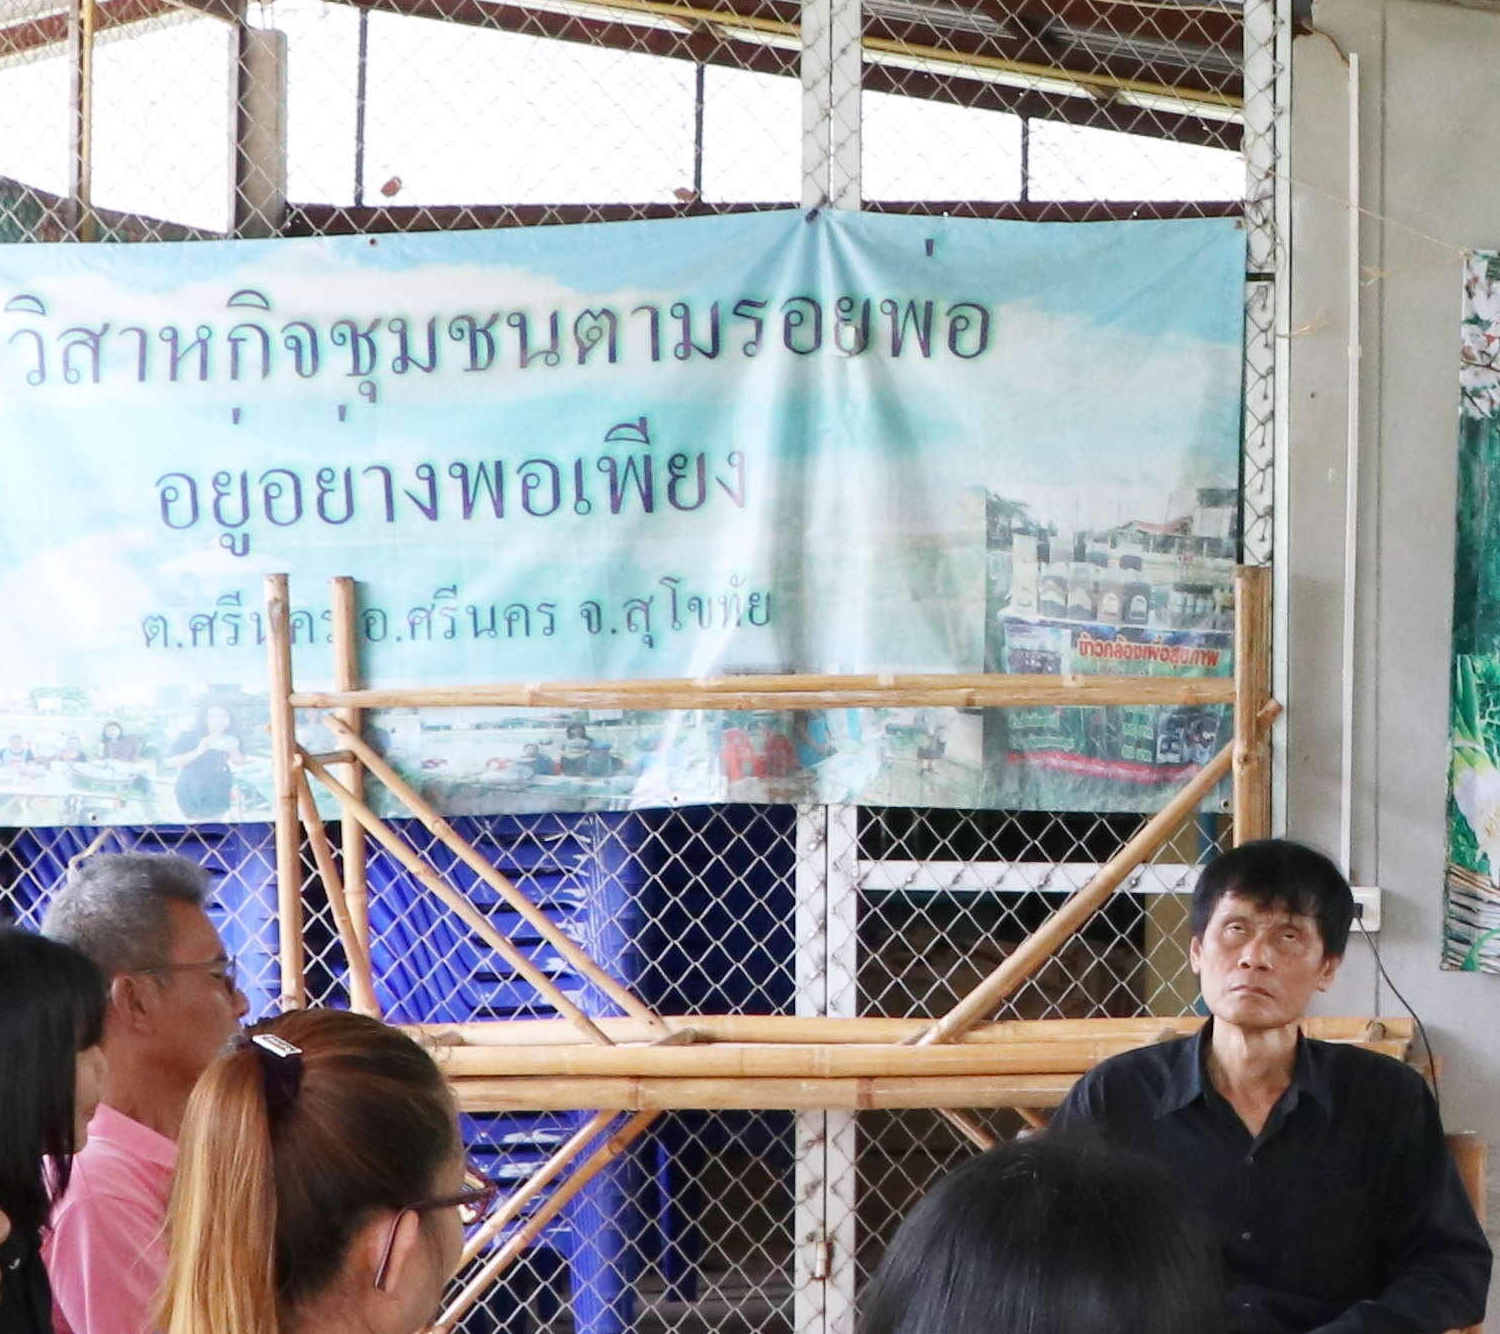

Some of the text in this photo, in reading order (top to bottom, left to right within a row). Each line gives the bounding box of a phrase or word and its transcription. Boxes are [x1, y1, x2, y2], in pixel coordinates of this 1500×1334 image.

[3, 237, 990, 403] วิสาหกิจชุมชนตามรอยพ่อ
[155, 405, 749, 556] อยู่อย่างพอเพียง
